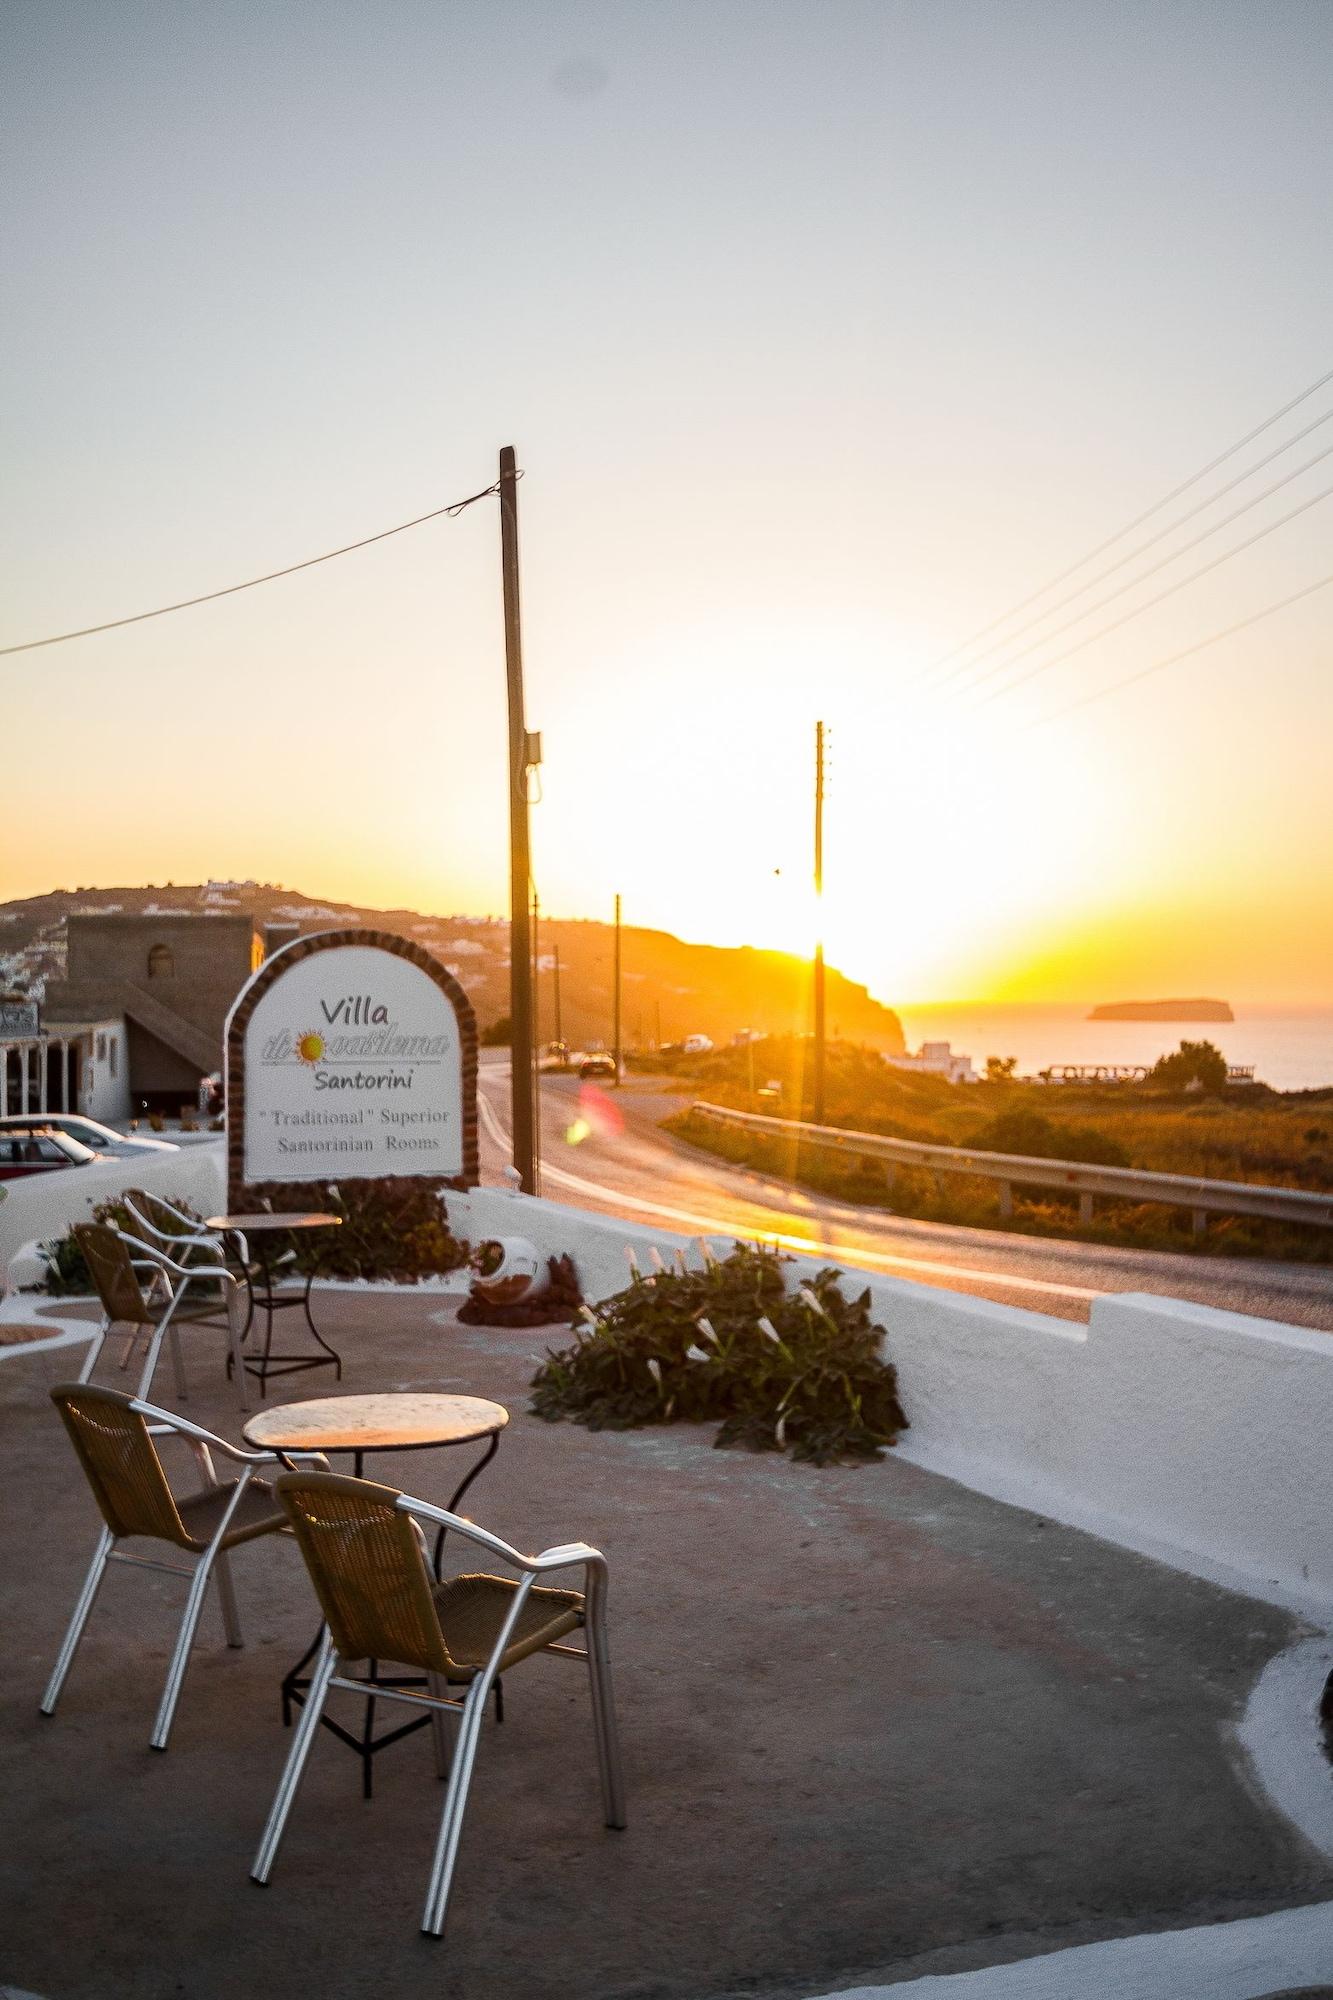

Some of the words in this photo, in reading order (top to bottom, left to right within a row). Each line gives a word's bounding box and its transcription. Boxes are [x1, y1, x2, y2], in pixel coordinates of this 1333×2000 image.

[320, 995, 389, 1025] Villa
[314, 1069, 415, 1091] Santorini
[380, 1108, 450, 1127] Superior
[277, 1136, 374, 1154] Santorinian
[385, 1135, 440, 1151] Rooms
